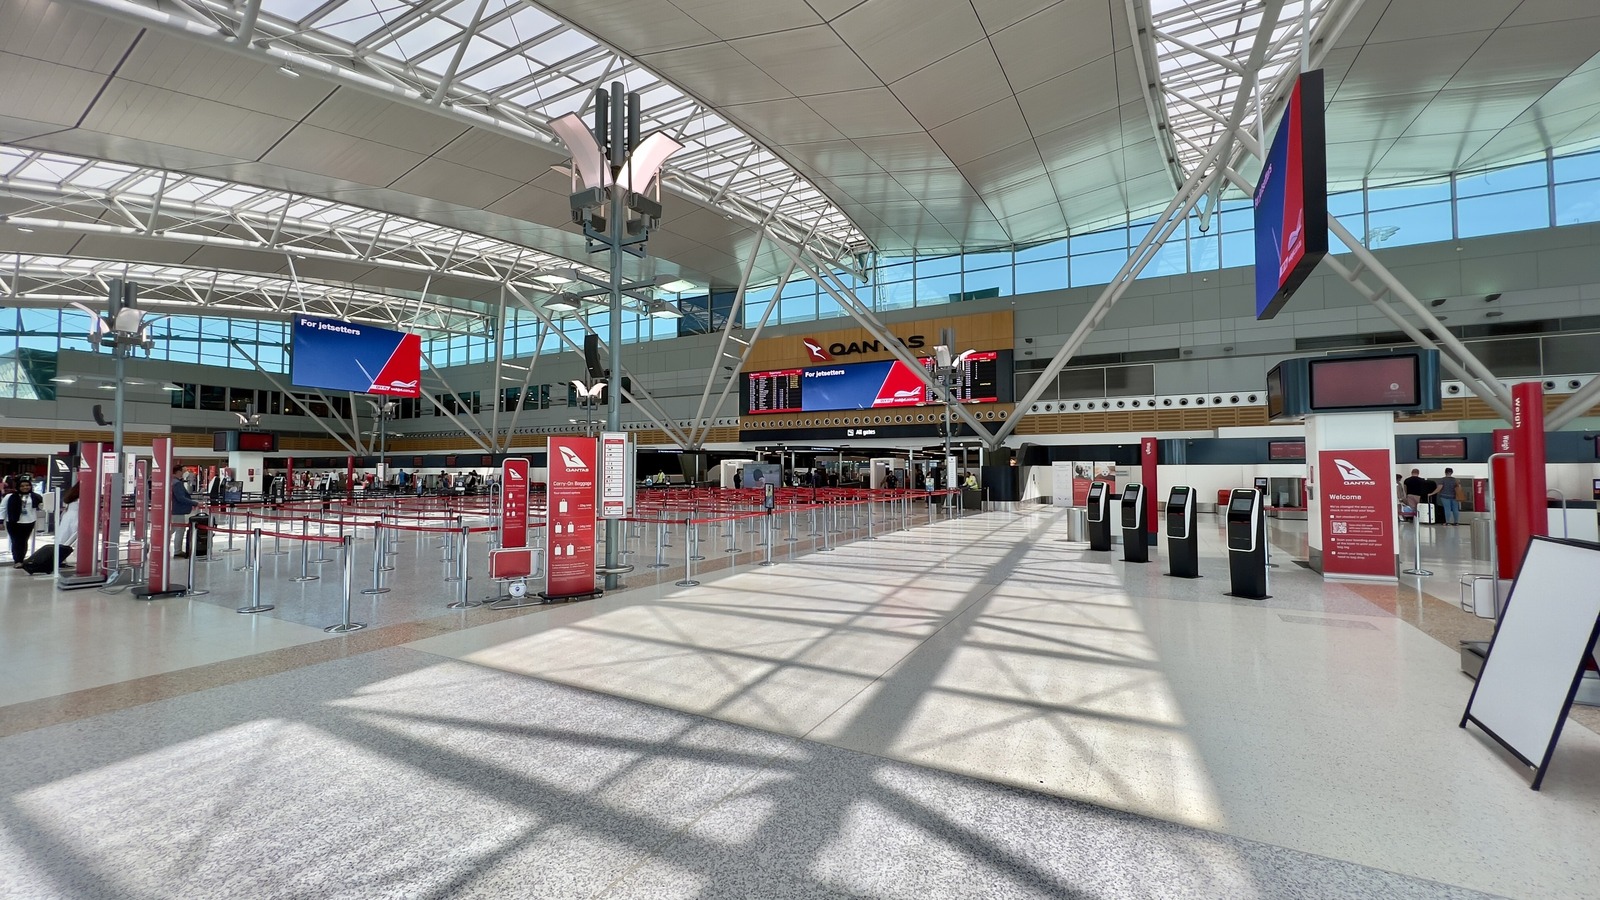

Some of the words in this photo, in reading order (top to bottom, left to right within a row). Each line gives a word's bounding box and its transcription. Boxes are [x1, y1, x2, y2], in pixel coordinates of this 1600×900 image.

[301, 319, 317, 327] For
[318, 322, 361, 336] jetsetters
[816, 369, 845, 378] jetsetters
[1501, 435, 1509, 450] Weigh
